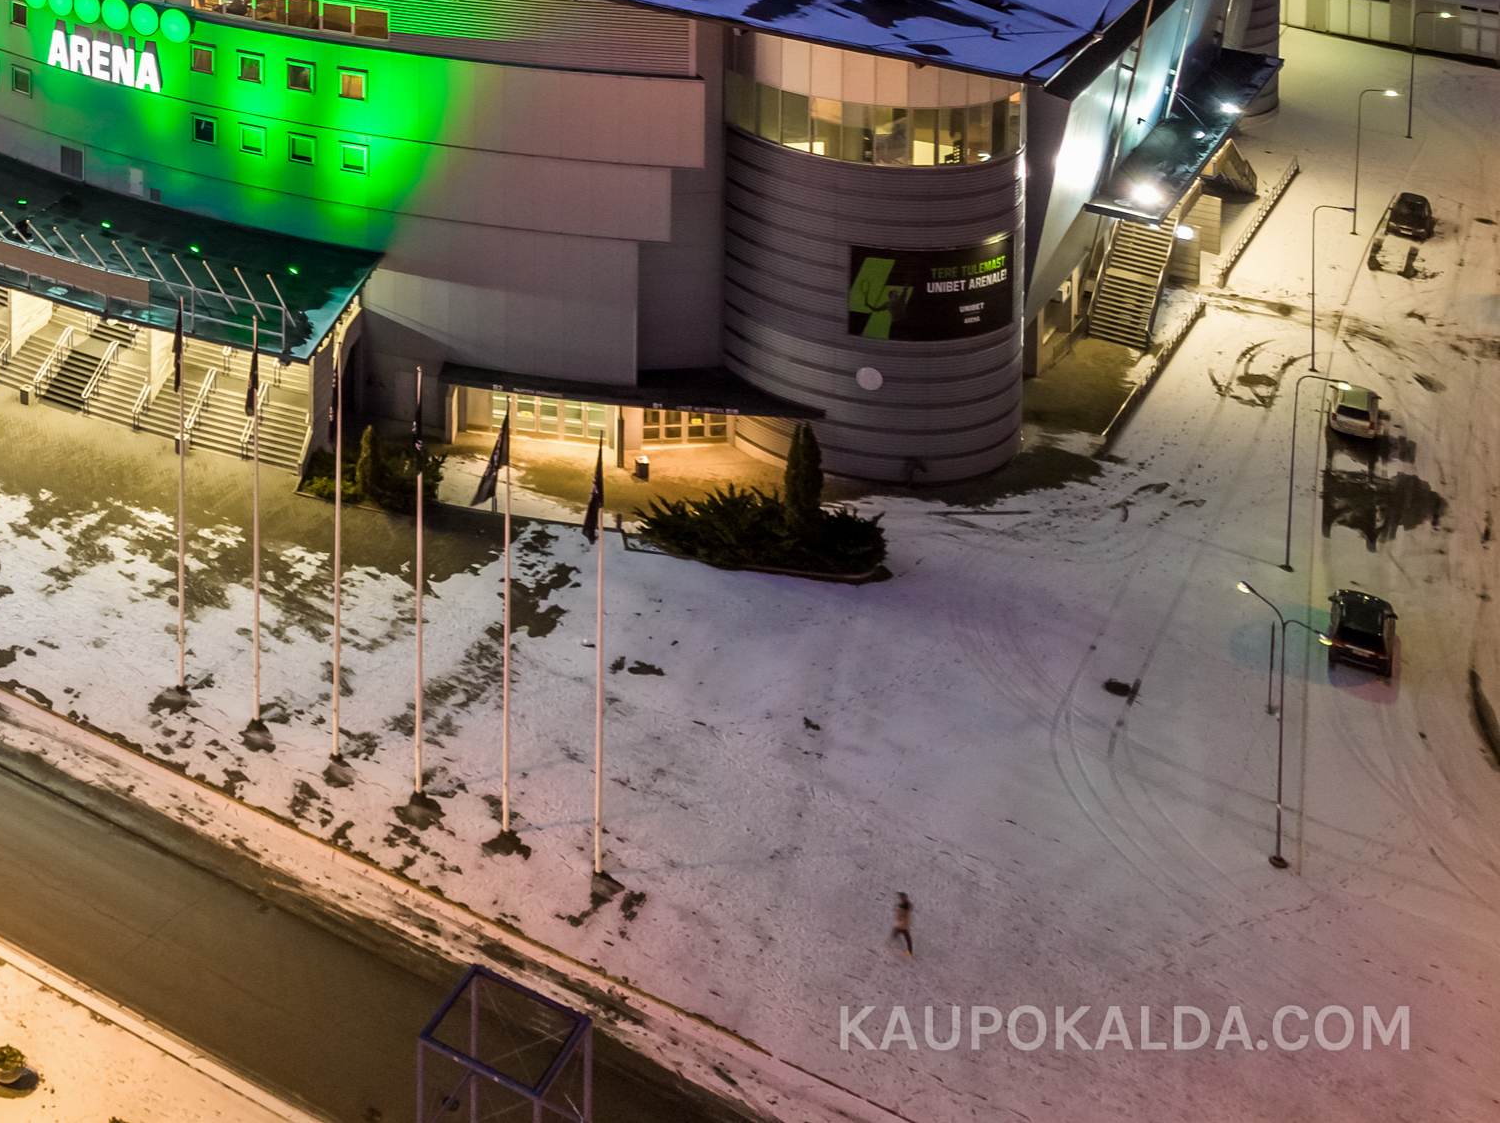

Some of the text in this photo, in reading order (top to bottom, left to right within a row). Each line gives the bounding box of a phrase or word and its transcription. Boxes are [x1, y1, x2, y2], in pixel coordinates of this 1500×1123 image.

[48, 28, 161, 92] ARENA
[962, 255, 1006, 276] TULEMAST
[926, 268, 1007, 293] UNIBET ARENALE!
